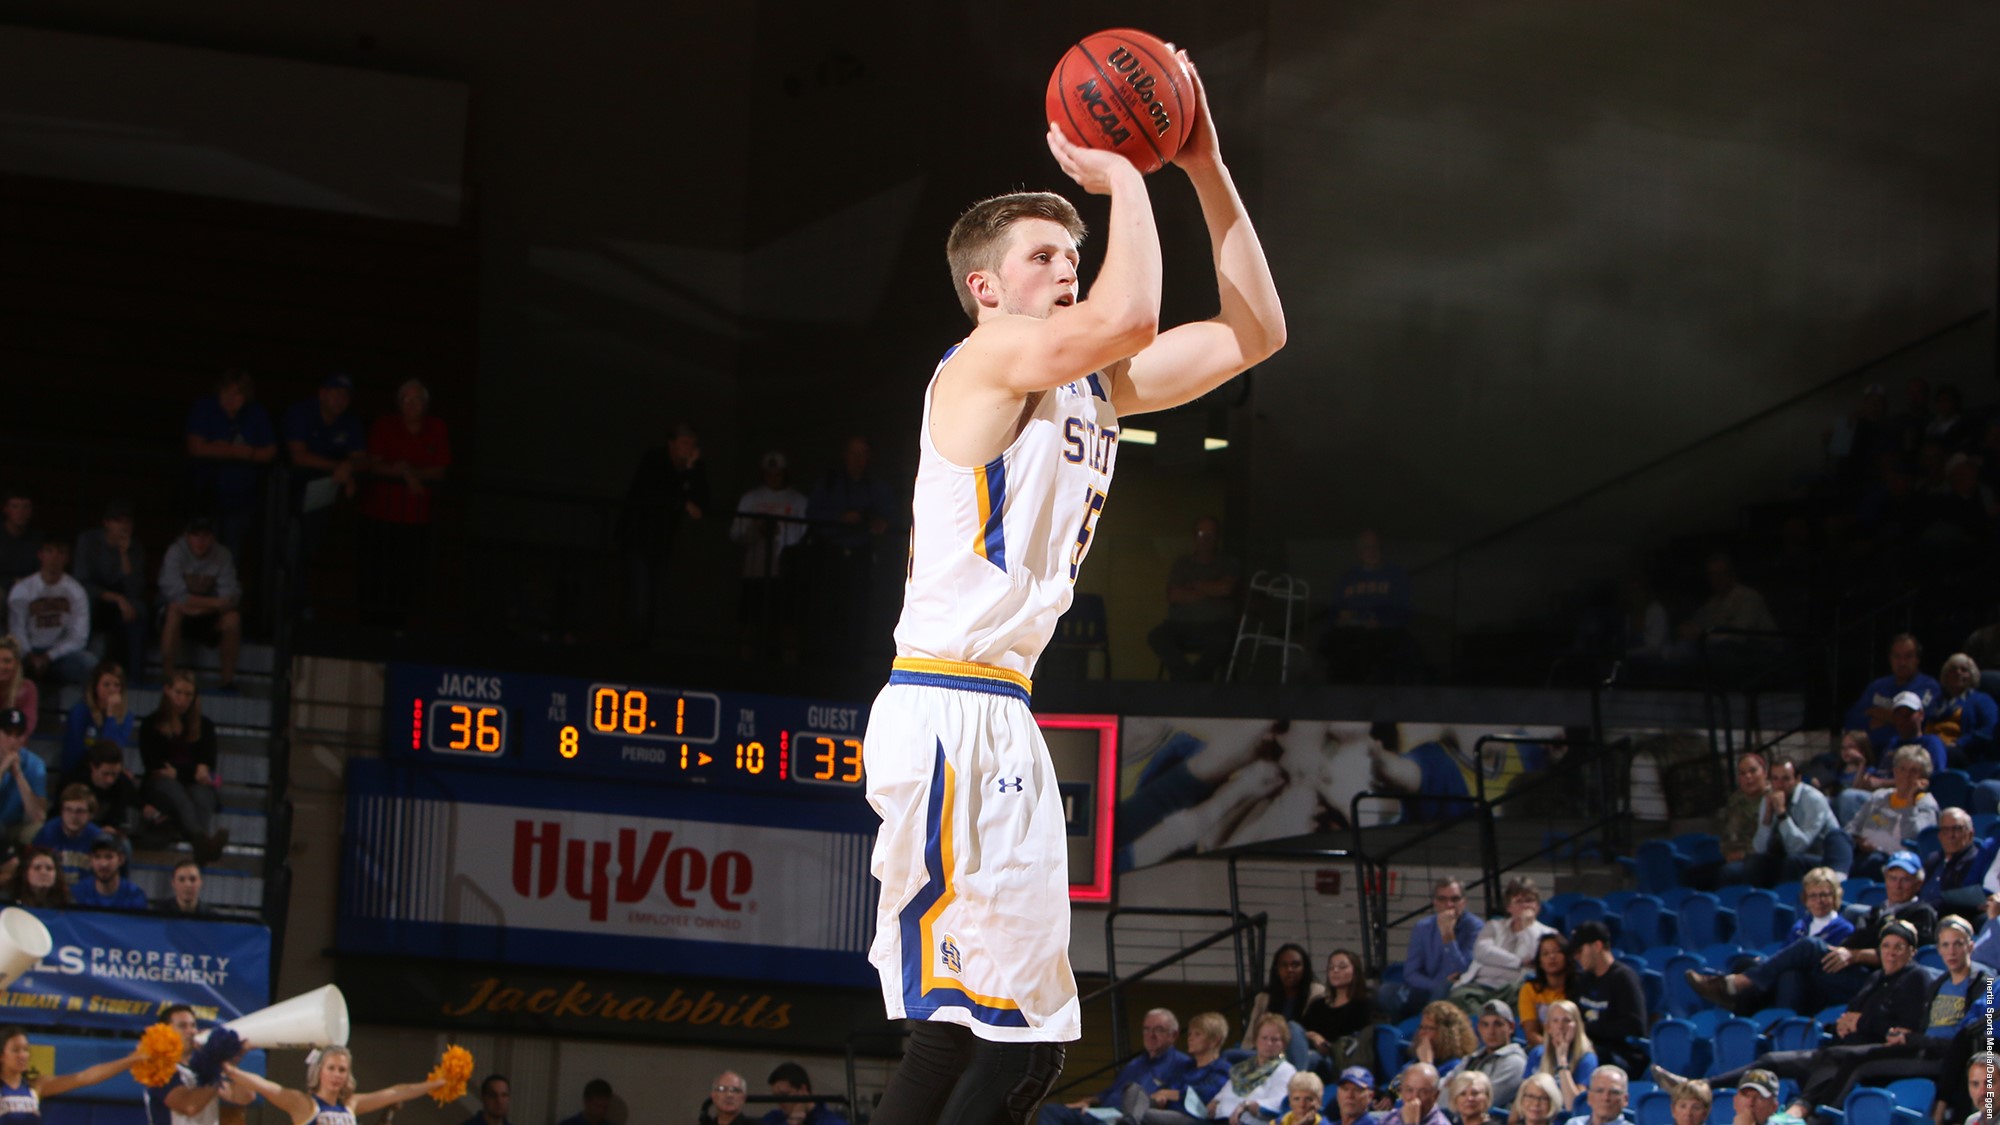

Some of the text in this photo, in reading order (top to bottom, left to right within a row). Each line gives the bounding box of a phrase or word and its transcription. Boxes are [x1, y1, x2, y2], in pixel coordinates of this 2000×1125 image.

[1106, 45, 1171, 138] Wilson
[1076, 79, 1131, 147] NCAA
[437, 673, 503, 700] JACKS
[593, 687, 686, 735] 08.1
[807, 705, 859, 731] GUEST
[449, 704, 501, 753] 36
[559, 725, 580, 760] 8
[621, 745, 667, 764] PERIOD
[679, 743, 689, 770] 1
[735, 741, 765, 775] 10
[814, 736, 863, 783] 33
[628, 911, 742, 930] EMPLOYEE OWNED
[91, 947, 230, 970] PROPERTY
[91, 963, 228, 986] MANAGEMENT
[443, 977, 793, 1030] Jackrabbits
